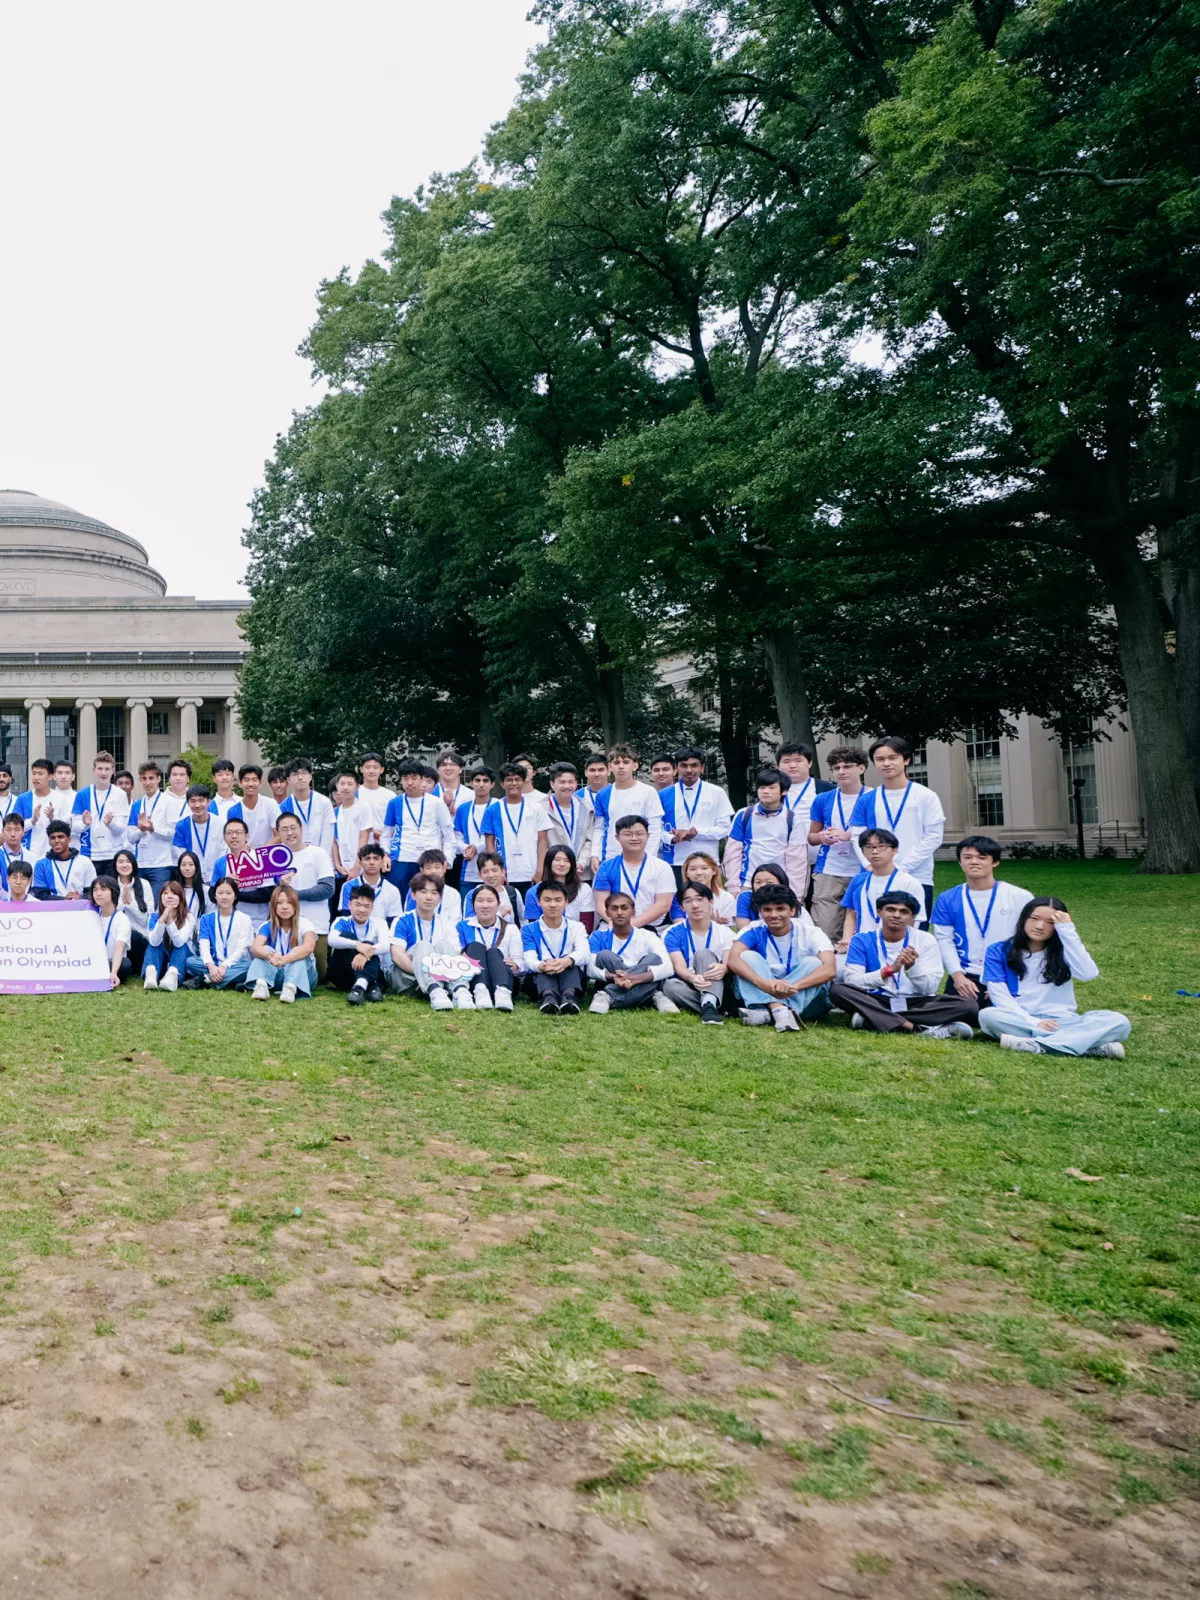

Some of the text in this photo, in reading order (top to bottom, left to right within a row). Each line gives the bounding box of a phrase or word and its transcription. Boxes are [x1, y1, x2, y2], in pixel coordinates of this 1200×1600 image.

[70, 672, 89, 683] OF
[101, 671, 216, 682] TECHNOLOGY
[53, 944, 67, 954] AI
[17, 956, 91, 969] Olympiad
